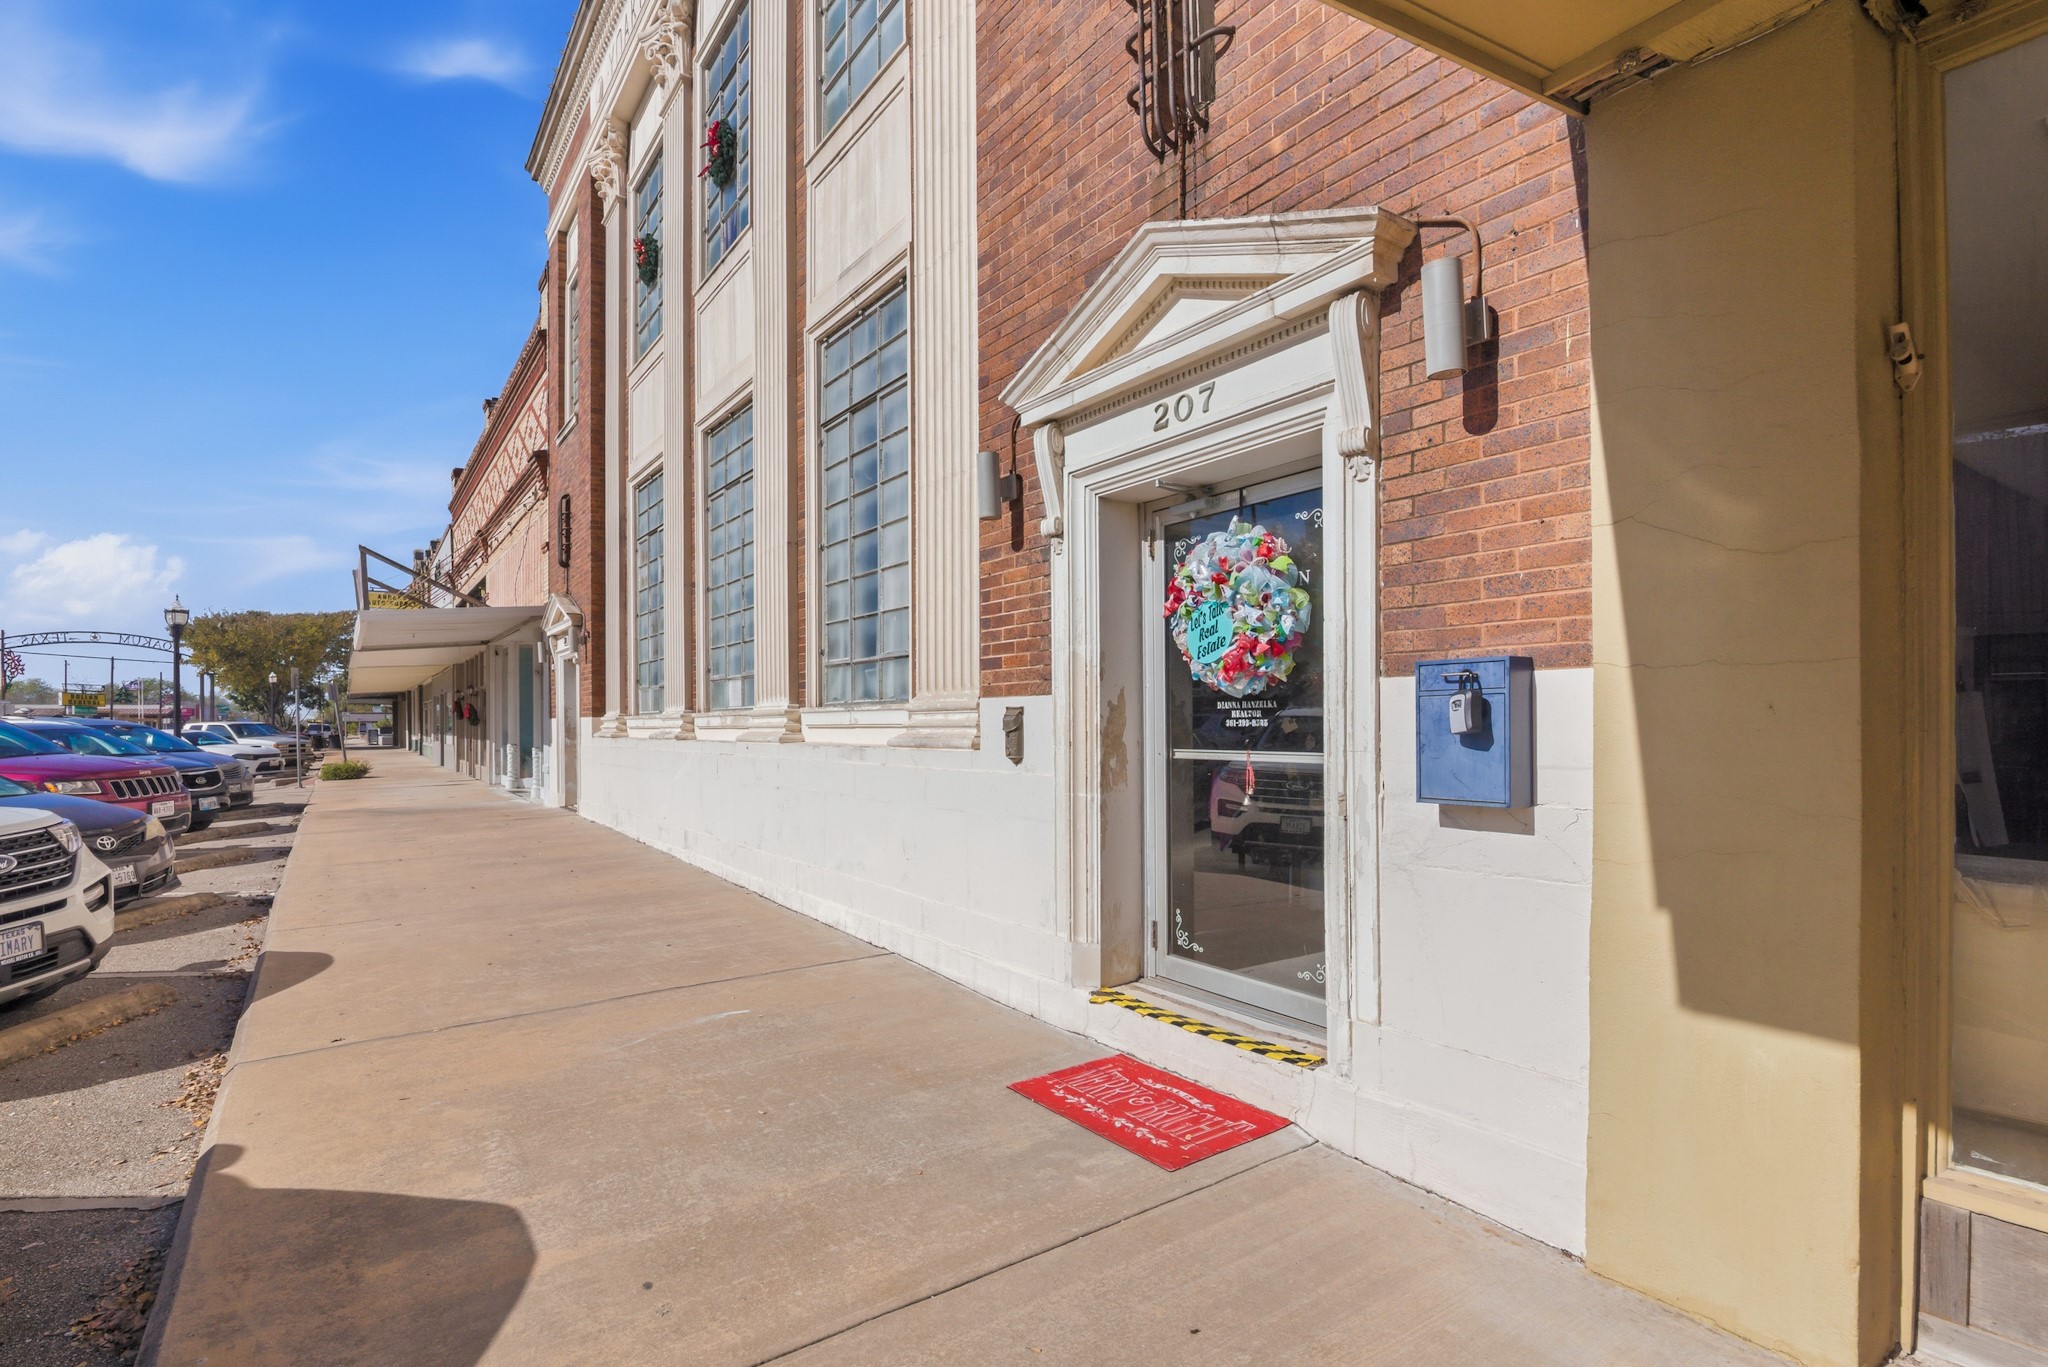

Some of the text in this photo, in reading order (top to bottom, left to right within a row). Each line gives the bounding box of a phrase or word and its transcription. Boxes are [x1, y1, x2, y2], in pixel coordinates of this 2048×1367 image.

[1153, 381, 1216, 433] 207
[1190, 602, 1225, 632] Let's Talk
[1199, 619, 1219, 643] Real
[1197, 635, 1227, 660] Estate
[1231, 710, 1262, 718] REALTOR
[115, 870, 136, 882] -5769
[0, 927, 26, 940] TEXAS
[1128, 1095, 1154, 1106] &
